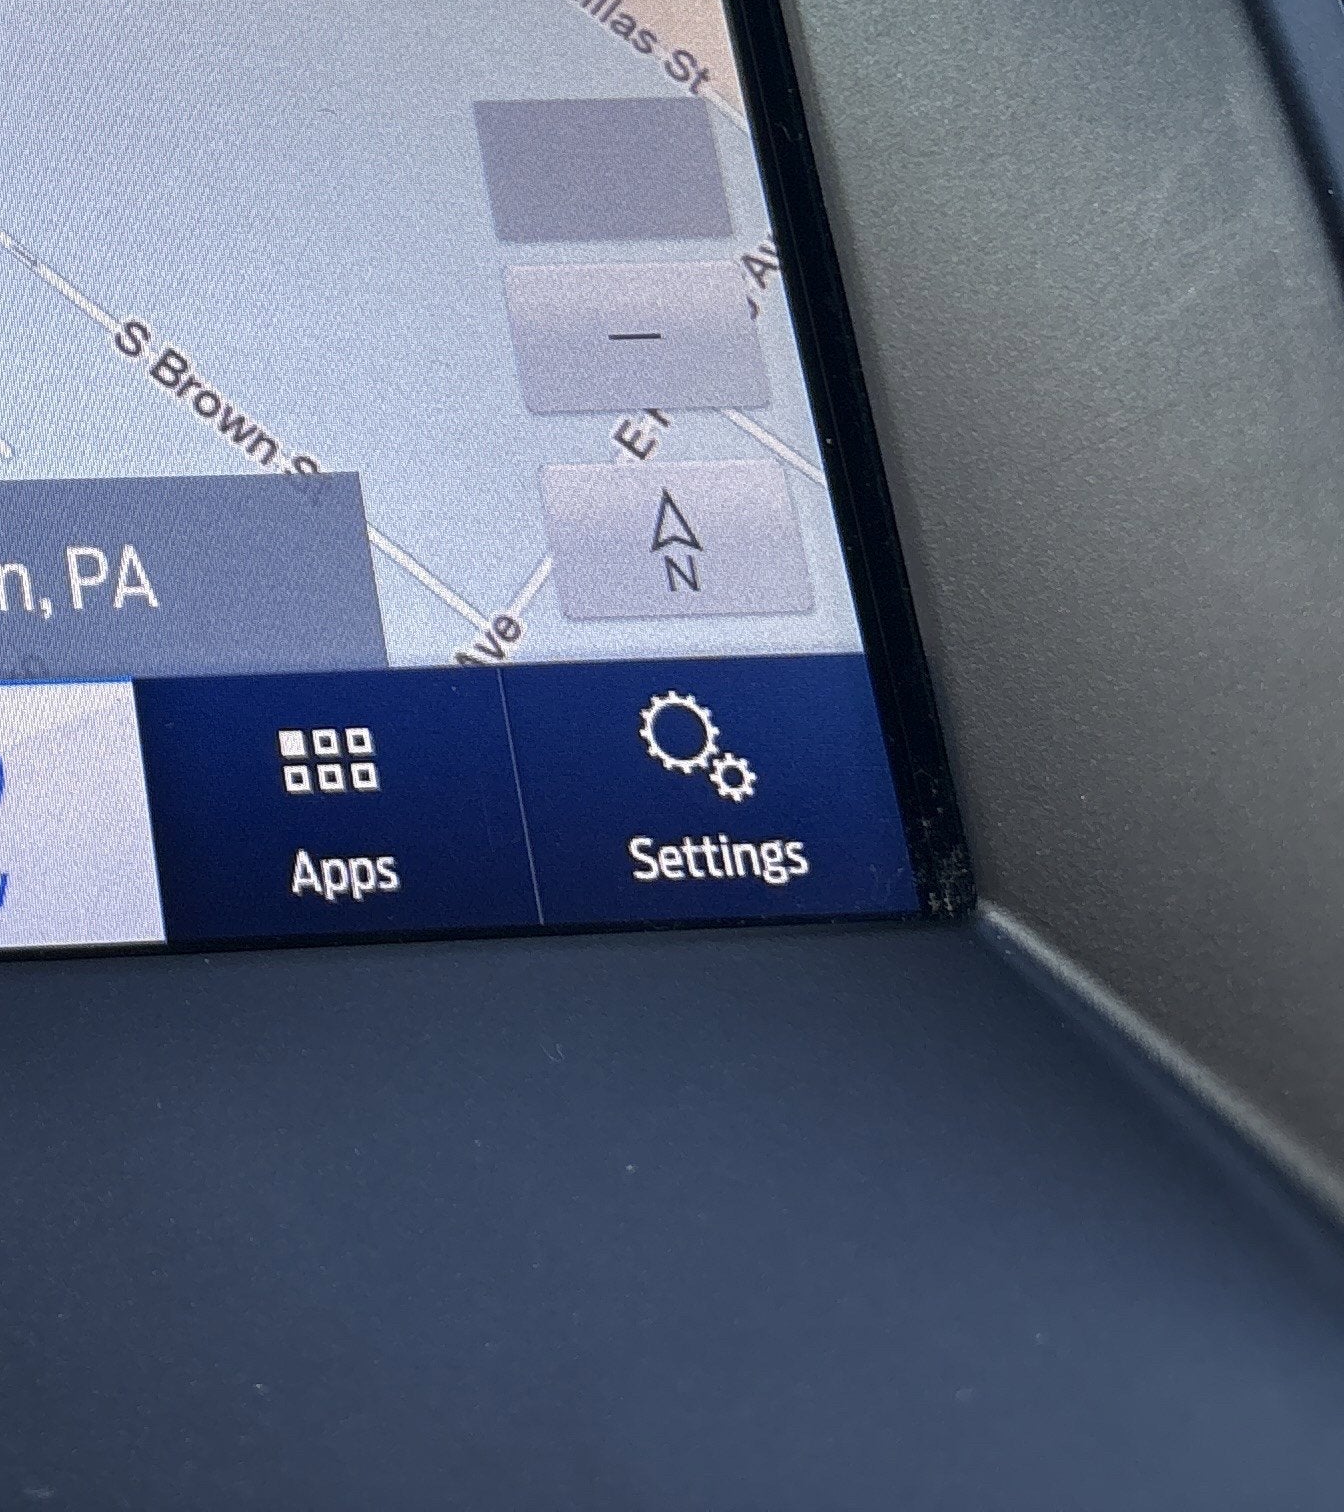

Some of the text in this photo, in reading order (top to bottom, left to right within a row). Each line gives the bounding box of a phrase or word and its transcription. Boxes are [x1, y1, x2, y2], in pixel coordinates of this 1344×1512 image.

[662, 48, 712, 95] St
[114, 319, 153, 359] S
[148, 347, 281, 466] Brown
[613, 420, 657, 460] E
[65, 544, 159, 611] PA
[665, 557, 700, 592] N
[291, 849, 400, 900] Apps
[629, 834, 809, 886] Settings
